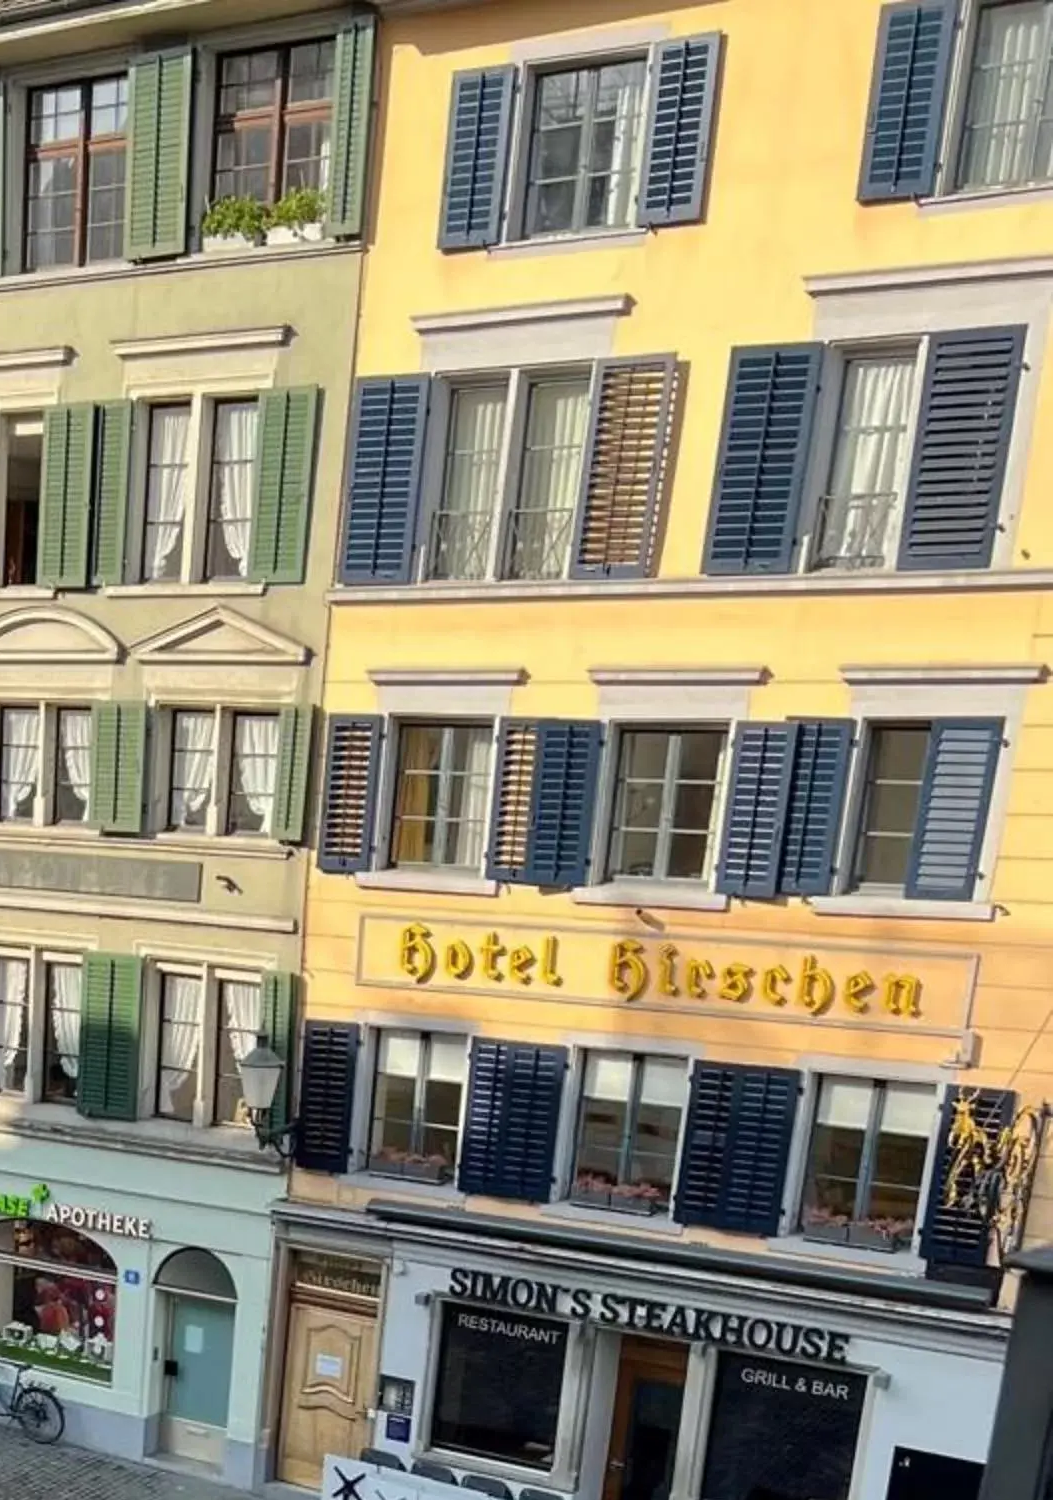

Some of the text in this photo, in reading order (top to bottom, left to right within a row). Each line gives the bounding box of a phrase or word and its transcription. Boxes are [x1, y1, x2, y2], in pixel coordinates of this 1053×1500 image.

[400, 921, 924, 1017] Hotel Hirschen
[45, 1203, 151, 1238] APOTHEKE
[458, 1312, 563, 1345] RESTAURANT
[599, 1292, 849, 1363] STEAKHOUSE
[740, 1367, 849, 1401] GRILL & BAR
